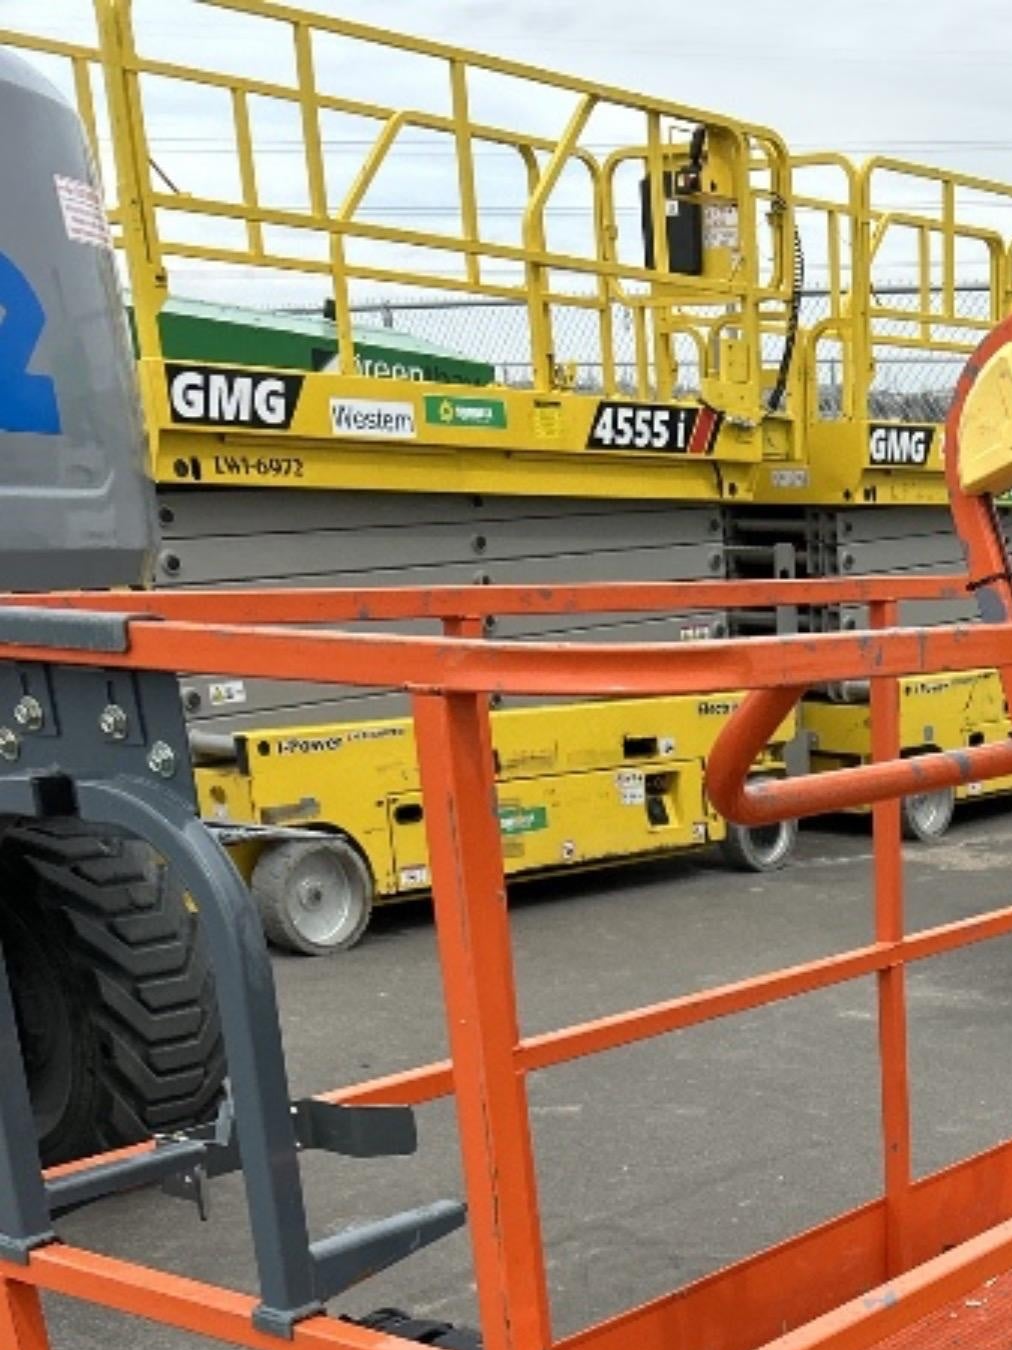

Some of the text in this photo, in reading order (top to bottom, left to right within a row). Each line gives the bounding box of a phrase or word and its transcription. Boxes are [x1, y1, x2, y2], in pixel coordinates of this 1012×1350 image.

[353, 351, 424, 382] reen
[170, 370, 286, 425] GMG
[593, 406, 670, 448] 4555
[869, 427, 926, 464] GMG
